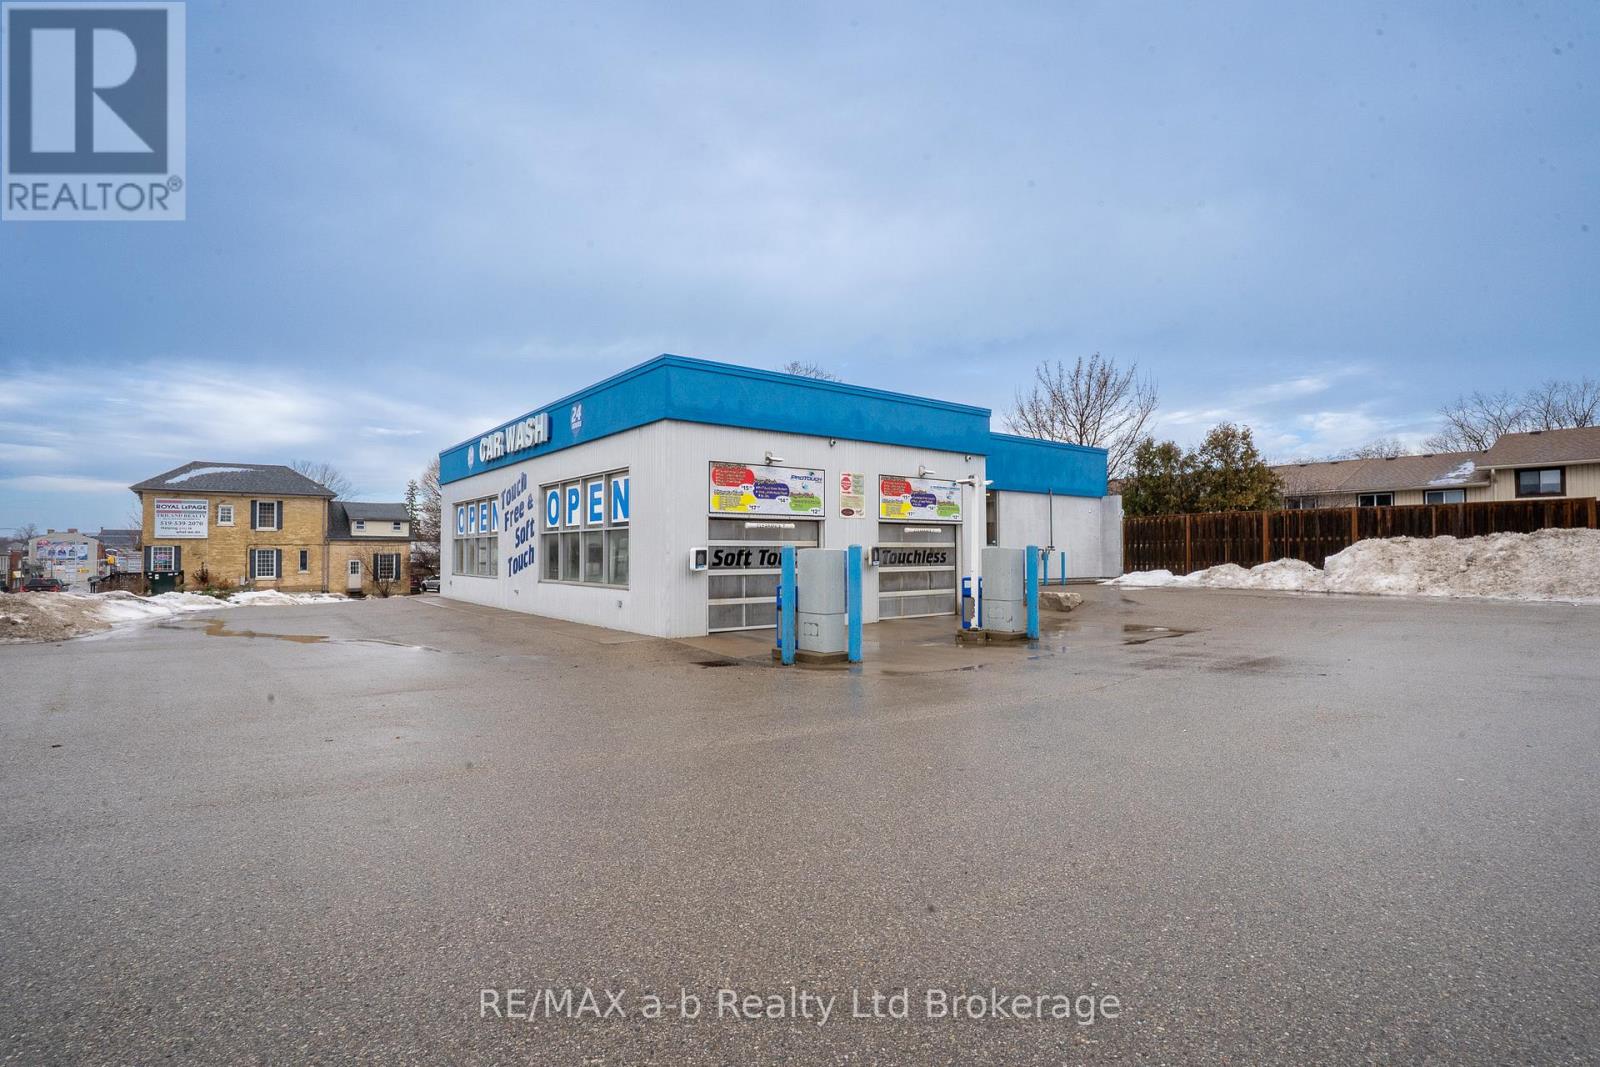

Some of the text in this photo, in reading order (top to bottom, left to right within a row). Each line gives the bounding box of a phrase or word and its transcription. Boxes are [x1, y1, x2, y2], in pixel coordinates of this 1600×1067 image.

[571, 404, 582, 423] 24
[480, 431, 504, 462] CAR
[505, 412, 549, 453] WASH
[501, 472, 527, 510] Touch
[547, 479, 630, 526] OPEN
[458, 502, 498, 533] OPEN
[504, 501, 525, 532] Free
[515, 517, 535, 549] Soft
[507, 544, 535, 578] Touch
[712, 549, 752, 566] Soft
[882, 549, 947, 565] Touchless
